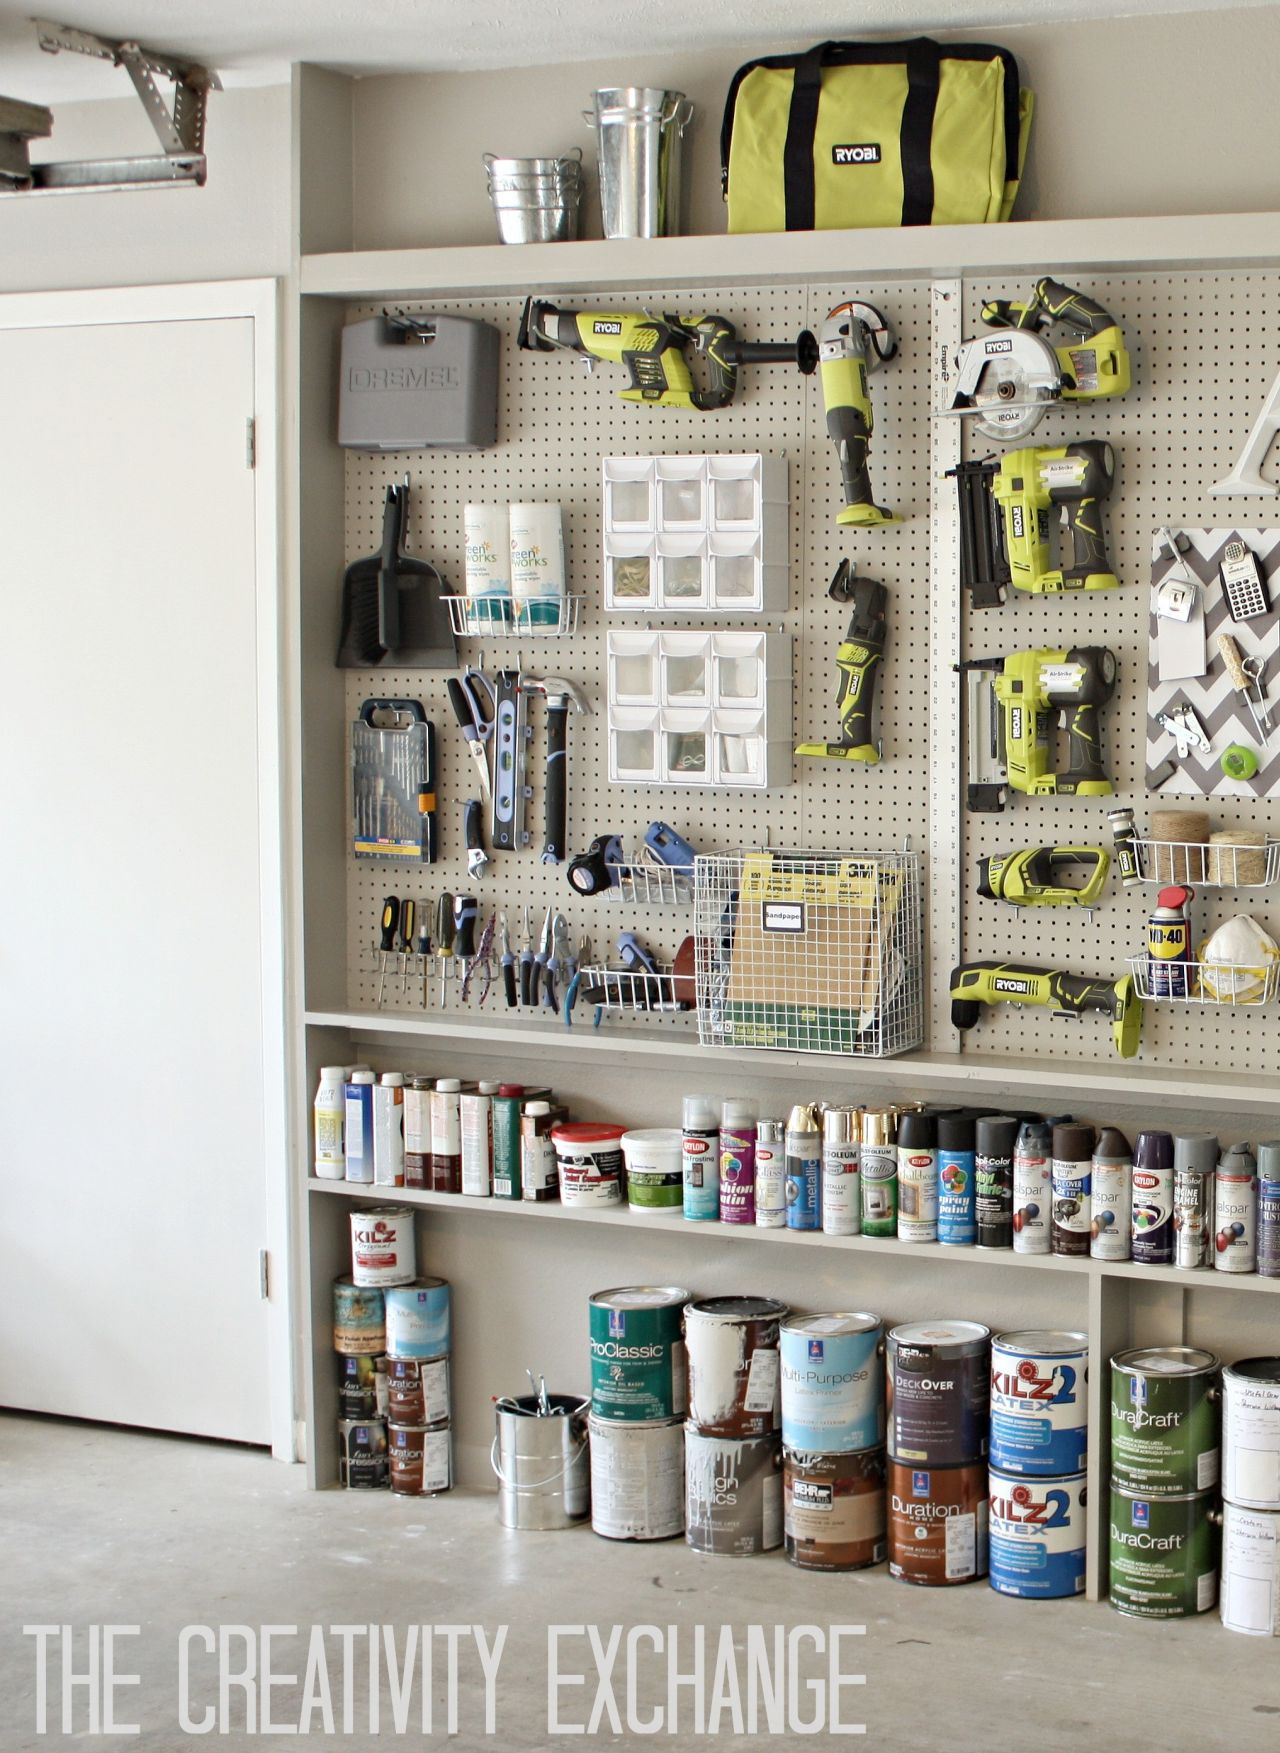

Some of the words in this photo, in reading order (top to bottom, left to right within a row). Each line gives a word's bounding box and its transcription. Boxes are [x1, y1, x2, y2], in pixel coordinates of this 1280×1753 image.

[836, 147, 877, 161] RYOBI
[594, 322, 621, 334] RYOBI
[986, 341, 1012, 353] RYOBI
[941, 345, 950, 381] Empire
[352, 366, 460, 391] DREMEL
[1013, 506, 1023, 538] RYOBI
[466, 544, 486, 555] een
[1012, 708, 1021, 739] RYOBI
[847, 863, 874, 879] 3M
[766, 911, 800, 921] Sandpape
[996, 980, 1028, 992] RYOBI
[910, 1157, 932, 1165] KRYLON
[720, 1183, 754, 1195] hion
[807, 1158, 819, 1208] metallic
[1133, 1175, 1157, 1188] KRYLON
[1091, 1191, 1120, 1203] alspar
[354, 1230, 397, 1244] KILZ
[991, 1367, 1055, 1401] KILZ
[1050, 1364, 1077, 1405] 2
[794, 1485, 819, 1497] BEHR
[891, 1494, 960, 1517] Duration
[988, 1494, 1048, 1526] KILZ
[1045, 1488, 1071, 1528] 2
[1111, 1525, 1182, 1550] DuraCraft
